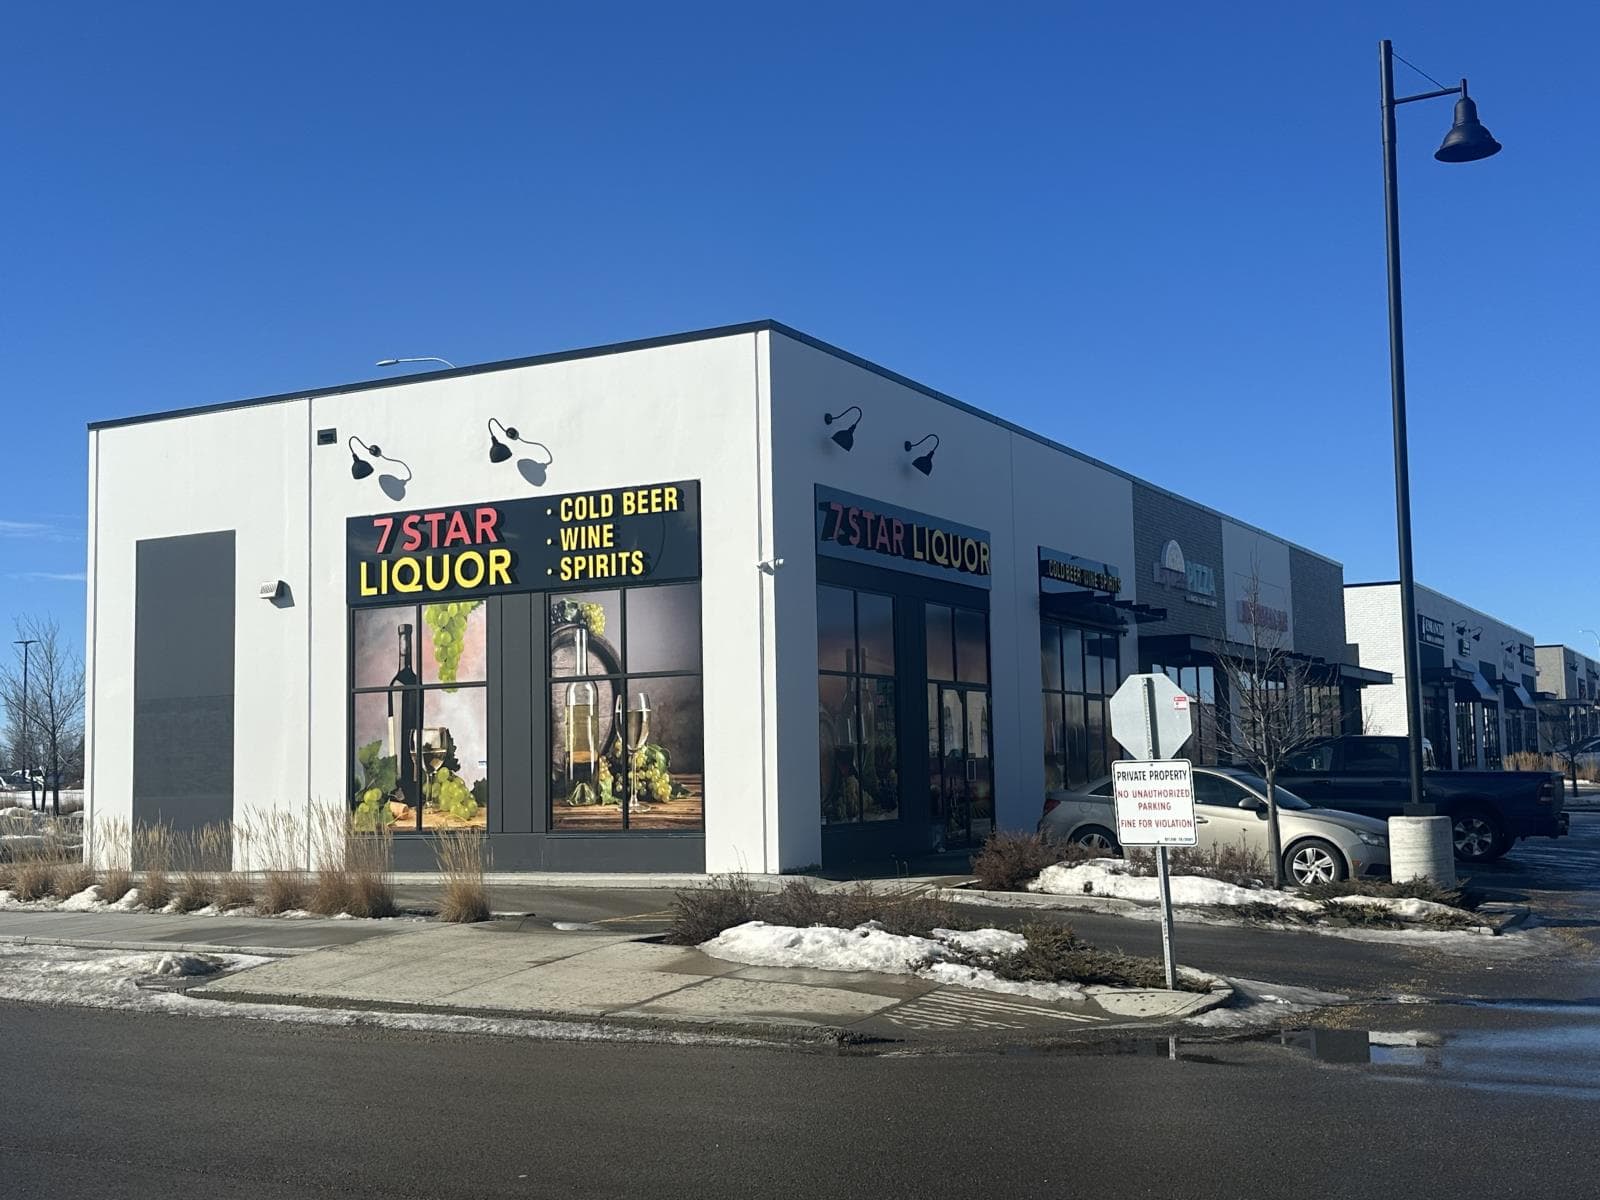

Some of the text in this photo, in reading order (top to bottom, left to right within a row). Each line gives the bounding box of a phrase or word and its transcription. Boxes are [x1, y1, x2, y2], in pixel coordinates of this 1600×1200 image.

[560, 486, 678, 522] COLD BEER
[373, 507, 498, 553] 7 STAR
[560, 524, 614, 552] WINE
[831, 503, 991, 574] 7 STAR LIQUOR
[360, 548, 513, 597] LIQUOR
[560, 550, 644, 582] SPIRITS
[1116, 770, 1187, 781] PRIVATE PROPERTY
[1117, 789, 1190, 798] NO UNAUTHORIZED
[1137, 802, 1172, 810] PARKING
[1121, 819, 1193, 828] FINE FOR VIOLATION
